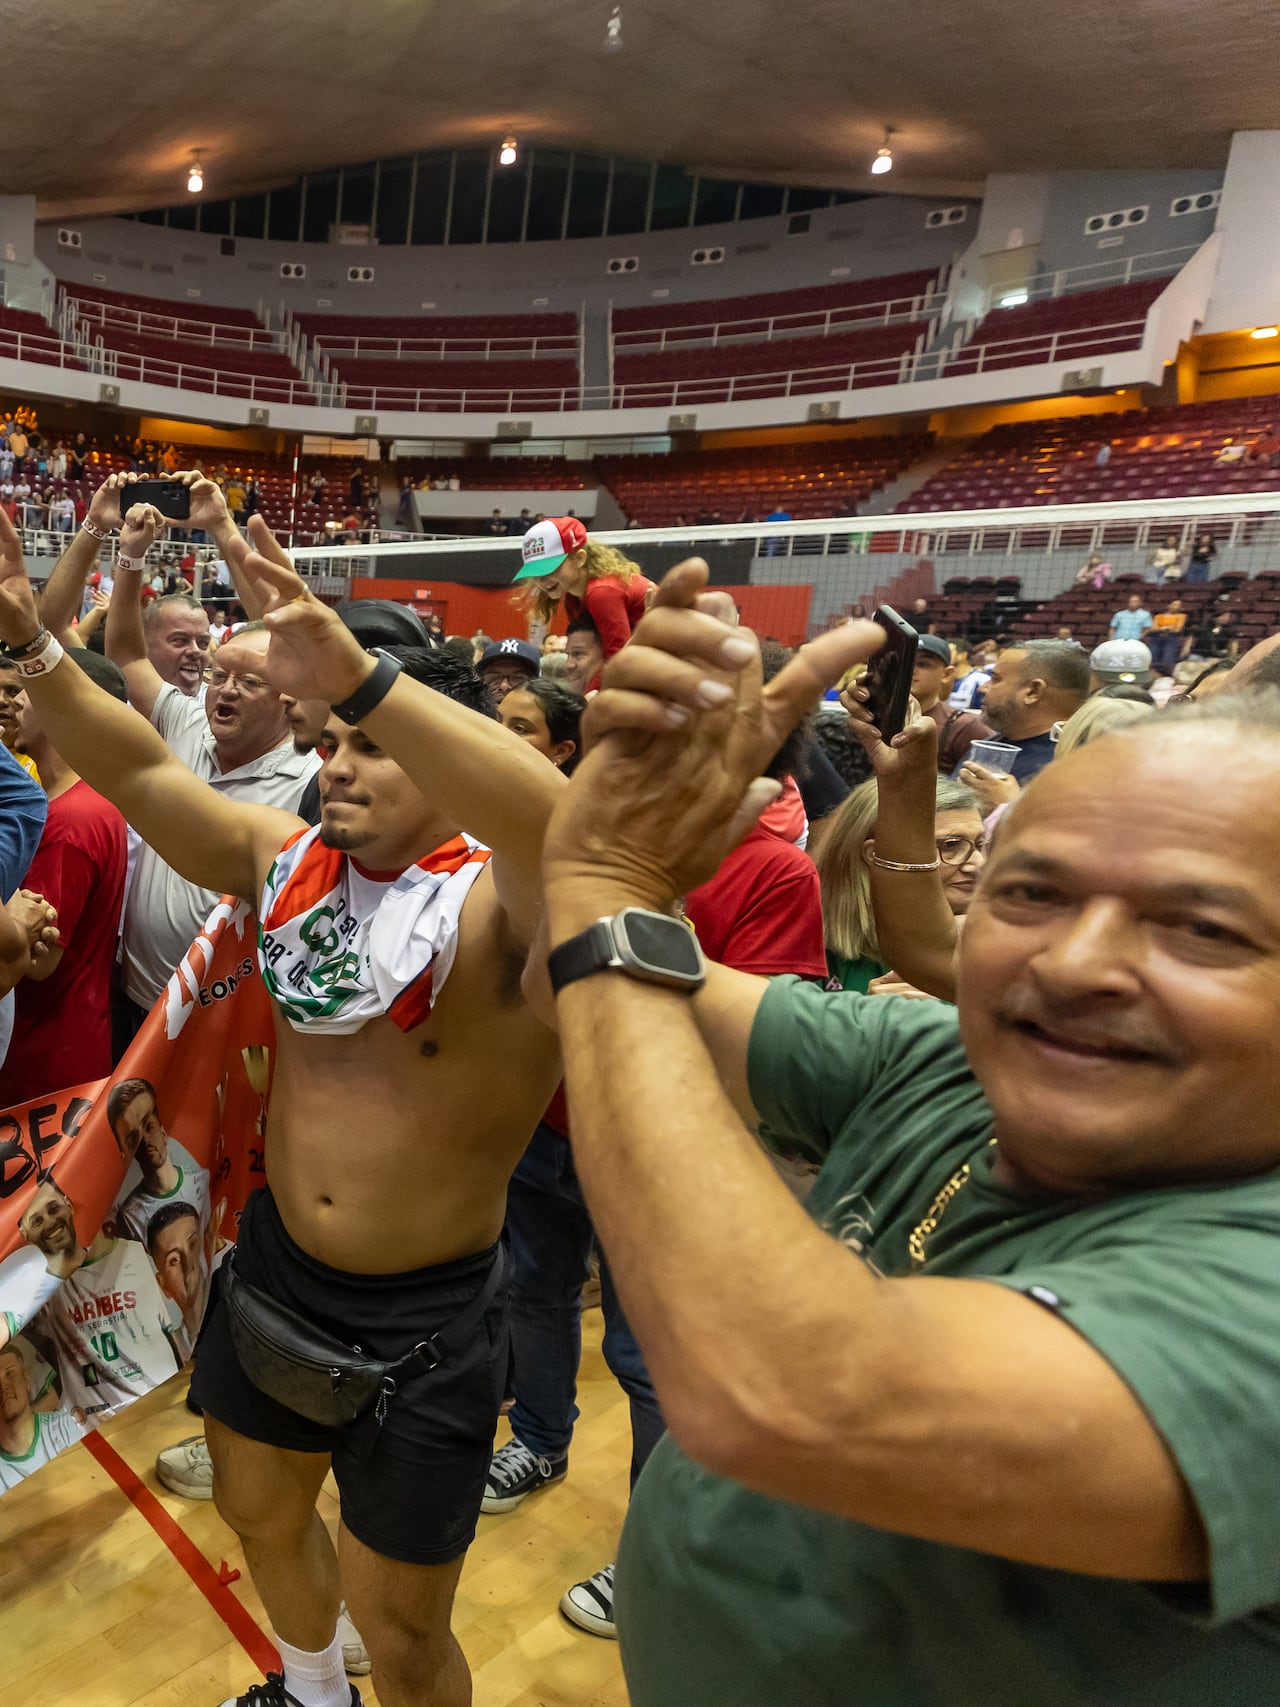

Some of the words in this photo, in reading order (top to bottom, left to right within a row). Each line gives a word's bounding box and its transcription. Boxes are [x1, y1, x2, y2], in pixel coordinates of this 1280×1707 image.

[500, 639, 519, 653] NY
[67, 1291, 137, 1324] ARIBES
[91, 1331, 120, 1361] 10
